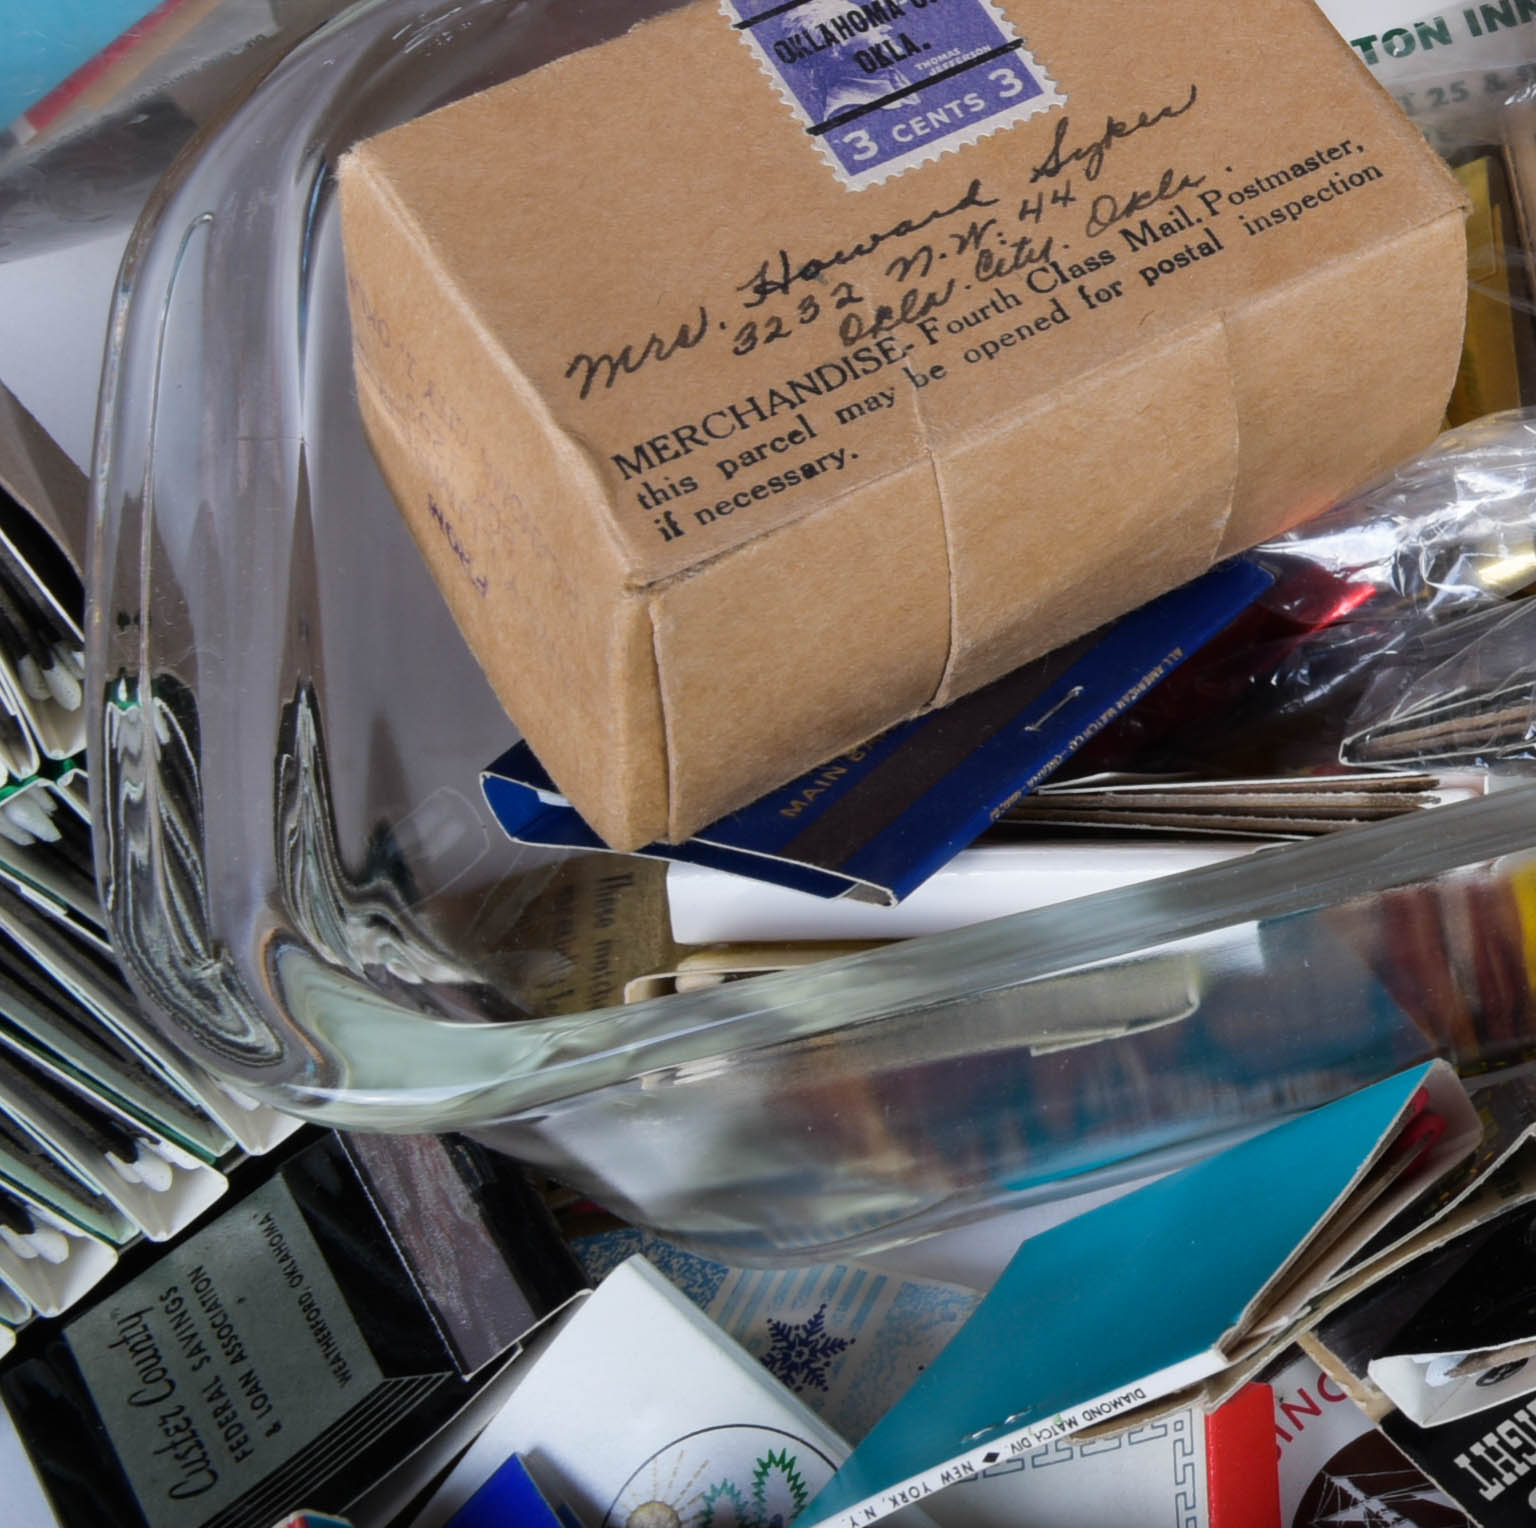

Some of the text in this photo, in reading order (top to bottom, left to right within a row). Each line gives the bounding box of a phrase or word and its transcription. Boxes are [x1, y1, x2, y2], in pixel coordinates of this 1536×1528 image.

[843, 68, 1025, 162] 3 CENTS 3
[854, 33, 932, 74] OKLA.
[564, 306, 727, 400] Mrs.
[737, 178, 1000, 308] Howard
[732, 181, 1077, 357] 3232 44
[918, 288, 1024, 347] Fourth
[1025, 248, 1117, 296] Class
[1198, 137, 1365, 218] Postmaster,
[637, 160, 1386, 511] this parcel may be opened for postal inspection
[654, 447, 860, 543] if necessary.
[780, 763, 848, 820] MAIN
[158, 1284, 255, 1464] FEDERAL SAVINGS
[187, 1264, 284, 1439] & LOAN ASSOCIATION
[257, 1211, 353, 1389] WEATHERFORD, OKLAHOMA
[108, 1306, 219, 1502] Custer County
[885, 1386, 1148, 1510] DIAMOND MATCH NEW YORK,
